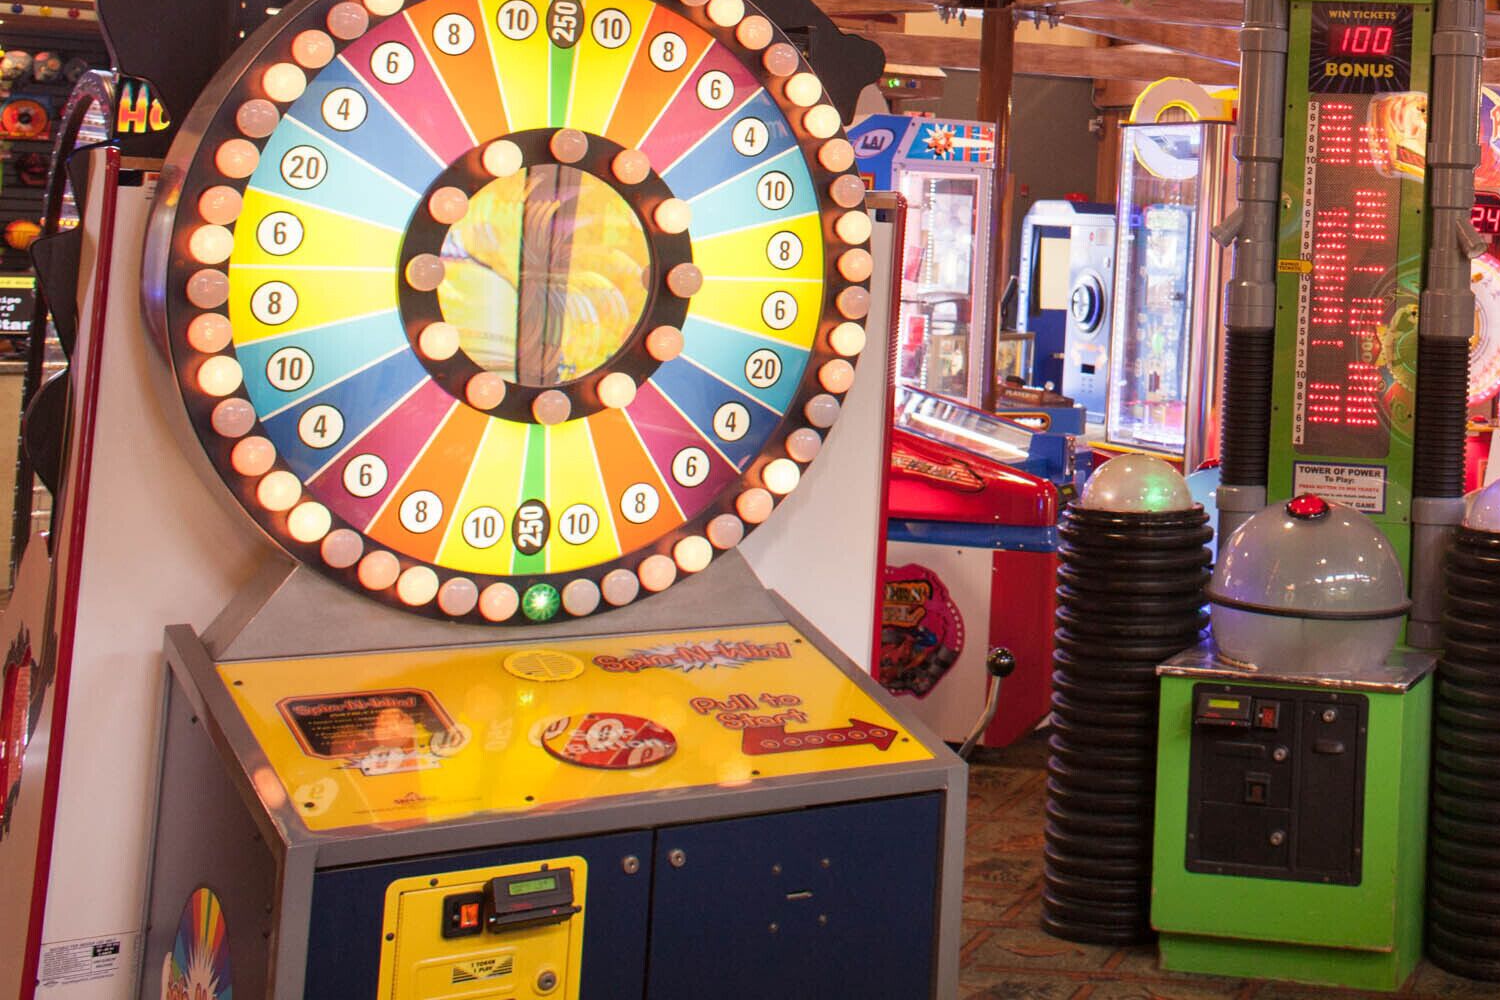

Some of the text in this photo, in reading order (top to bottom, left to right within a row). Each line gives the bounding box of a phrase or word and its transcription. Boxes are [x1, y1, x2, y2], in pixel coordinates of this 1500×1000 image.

[506, 8, 529, 31] 10
[553, 0, 578, 41] 250
[1329, 10, 1397, 20] WIN TICKETS
[448, 23, 460, 45] 8
[600, 17, 623, 40] 10
[1341, 26, 1393, 54] 100
[386, 51, 399, 74] 6
[663, 41, 674, 62] 8
[1325, 61, 1394, 78] BONUS
[710, 79, 721, 100] 6
[337, 98, 349, 121] 4
[744, 127, 755, 147] 4
[860, 135, 886, 150] LAI
[290, 155, 319, 179] 20
[765, 181, 785, 201] 10
[273, 222, 286, 245] 6
[780, 240, 790, 261] 8
[268, 291, 281, 315] 8
[775, 299, 785, 321] 6
[277, 357, 303, 381] 10
[751, 358, 776, 380] 20
[313, 415, 327, 438] 4
[725, 411, 737, 433] 4
[359, 463, 372, 487] 6
[686, 456, 697, 478] 6
[1299, 466, 1381, 477] TOWER OF POWER
[415, 500, 427, 523] 8
[635, 492, 645, 514] 8
[473, 516, 495, 538] 10
[518, 505, 543, 548] 250
[569, 513, 590, 535] 10
[592, 642, 793, 673] Spin-N-Win!
[689, 693, 803, 715] Pull to
[716, 709, 809, 730] Start
